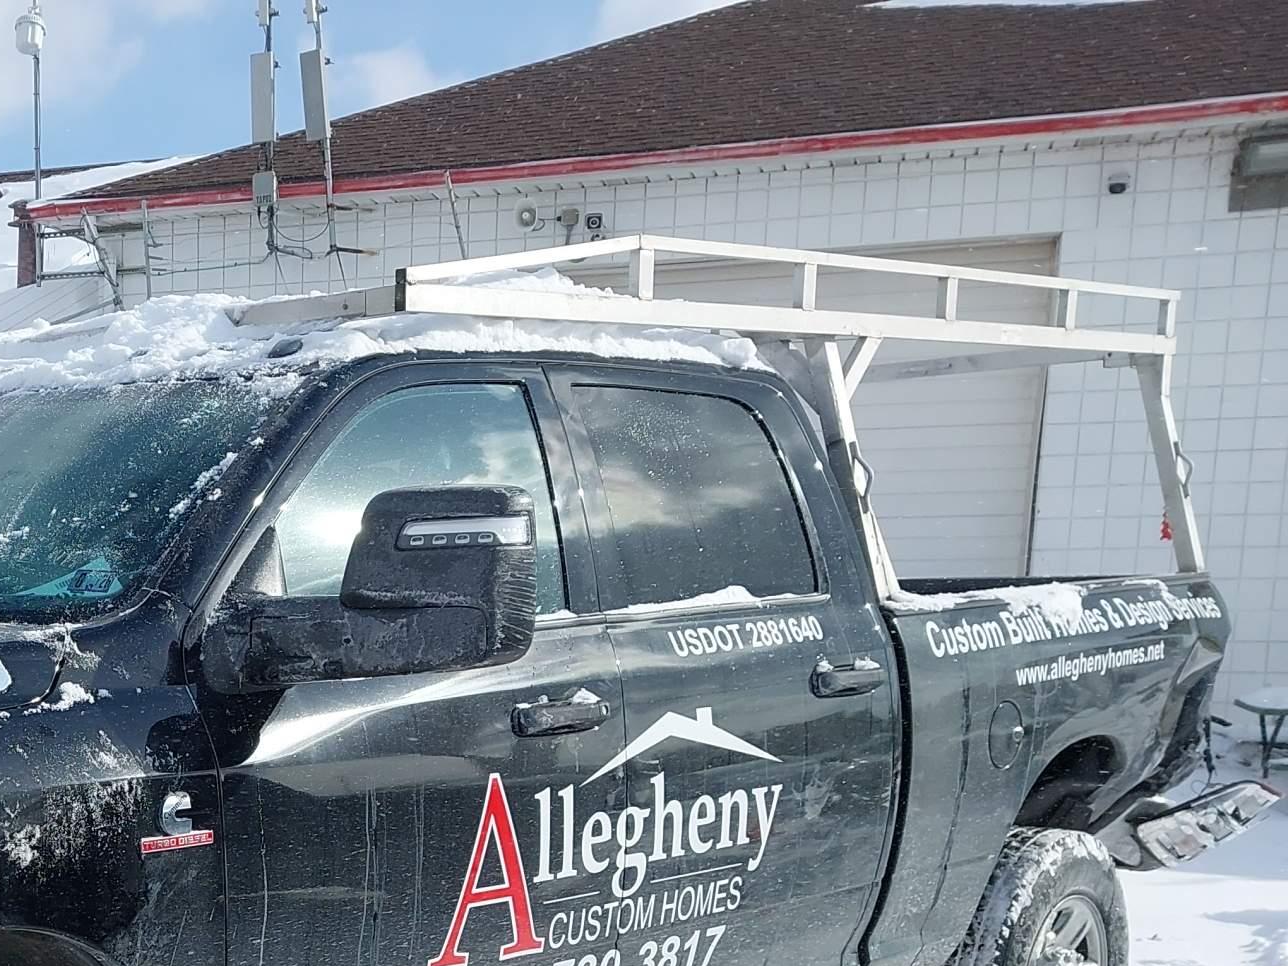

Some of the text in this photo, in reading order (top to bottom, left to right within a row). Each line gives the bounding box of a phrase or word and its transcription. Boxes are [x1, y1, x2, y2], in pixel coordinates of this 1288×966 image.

[998, 604, 1052, 645] Built
[1099, 598, 1125, 629] &
[1111, 594, 1174, 631] Design
[1171, 591, 1222, 621] Services
[667, 615, 824, 658] USDOT 2881640
[925, 618, 1006, 658] Custom
[1015, 639, 1165, 687] www.alleghenyhomes.net
[143, 832, 213, 851] TURBO DIESEL
[547, 875, 744, 949] CUSTOM HOMES
